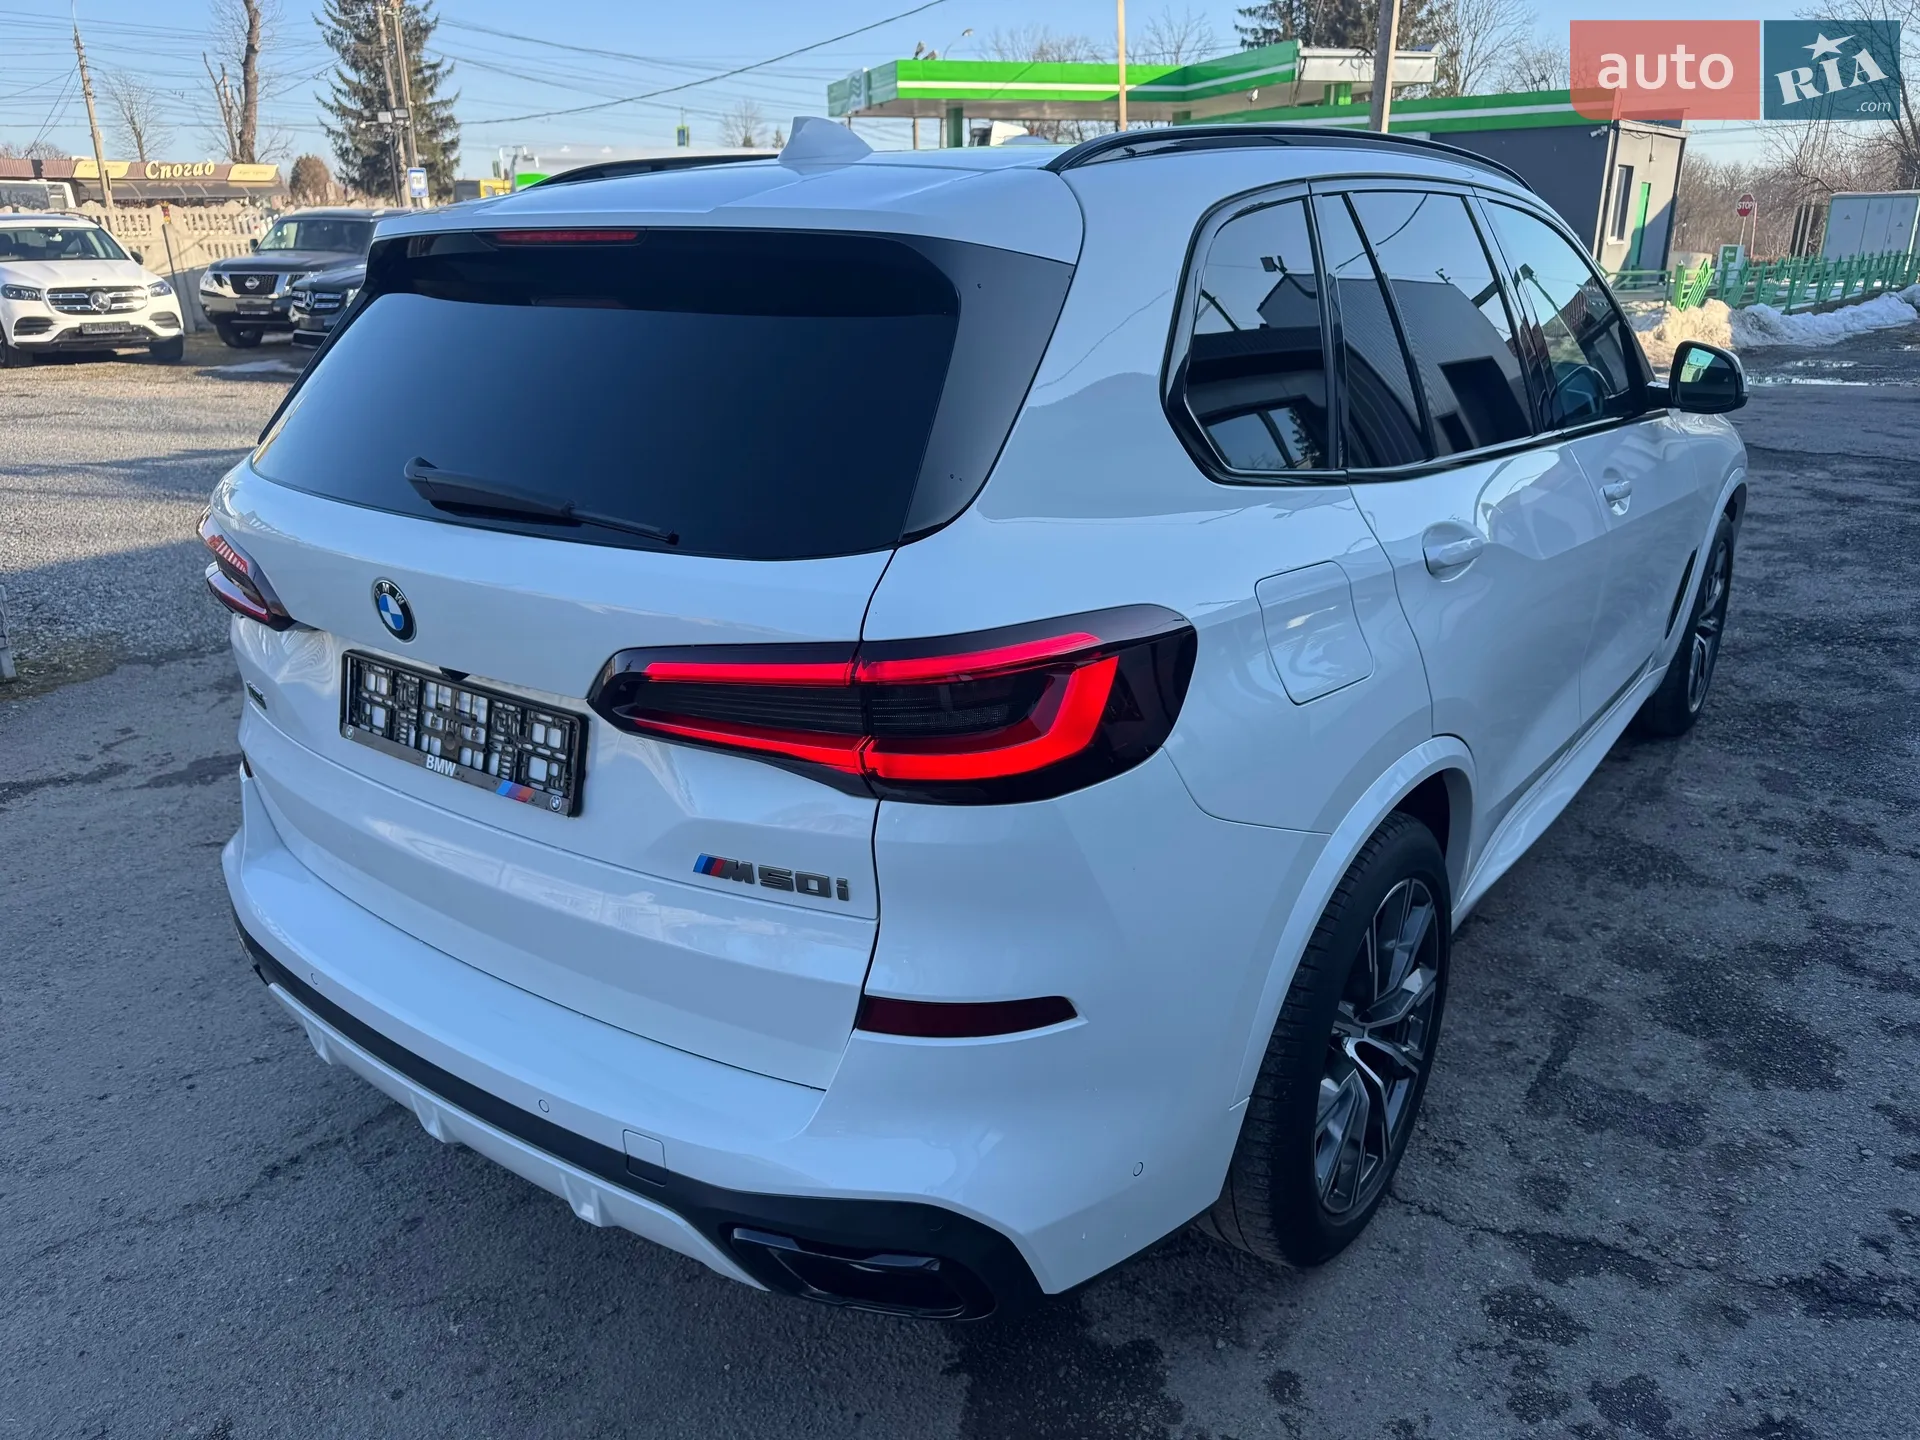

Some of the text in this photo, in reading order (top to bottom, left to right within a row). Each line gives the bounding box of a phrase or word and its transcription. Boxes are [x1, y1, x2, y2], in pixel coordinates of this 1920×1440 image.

[145, 158, 215, 180] Спогад
[1737, 201, 1754, 210] STOP
[374, 582, 405, 606] BMW
[426, 754, 457, 777] BMW
[714, 855, 849, 902] M50i
